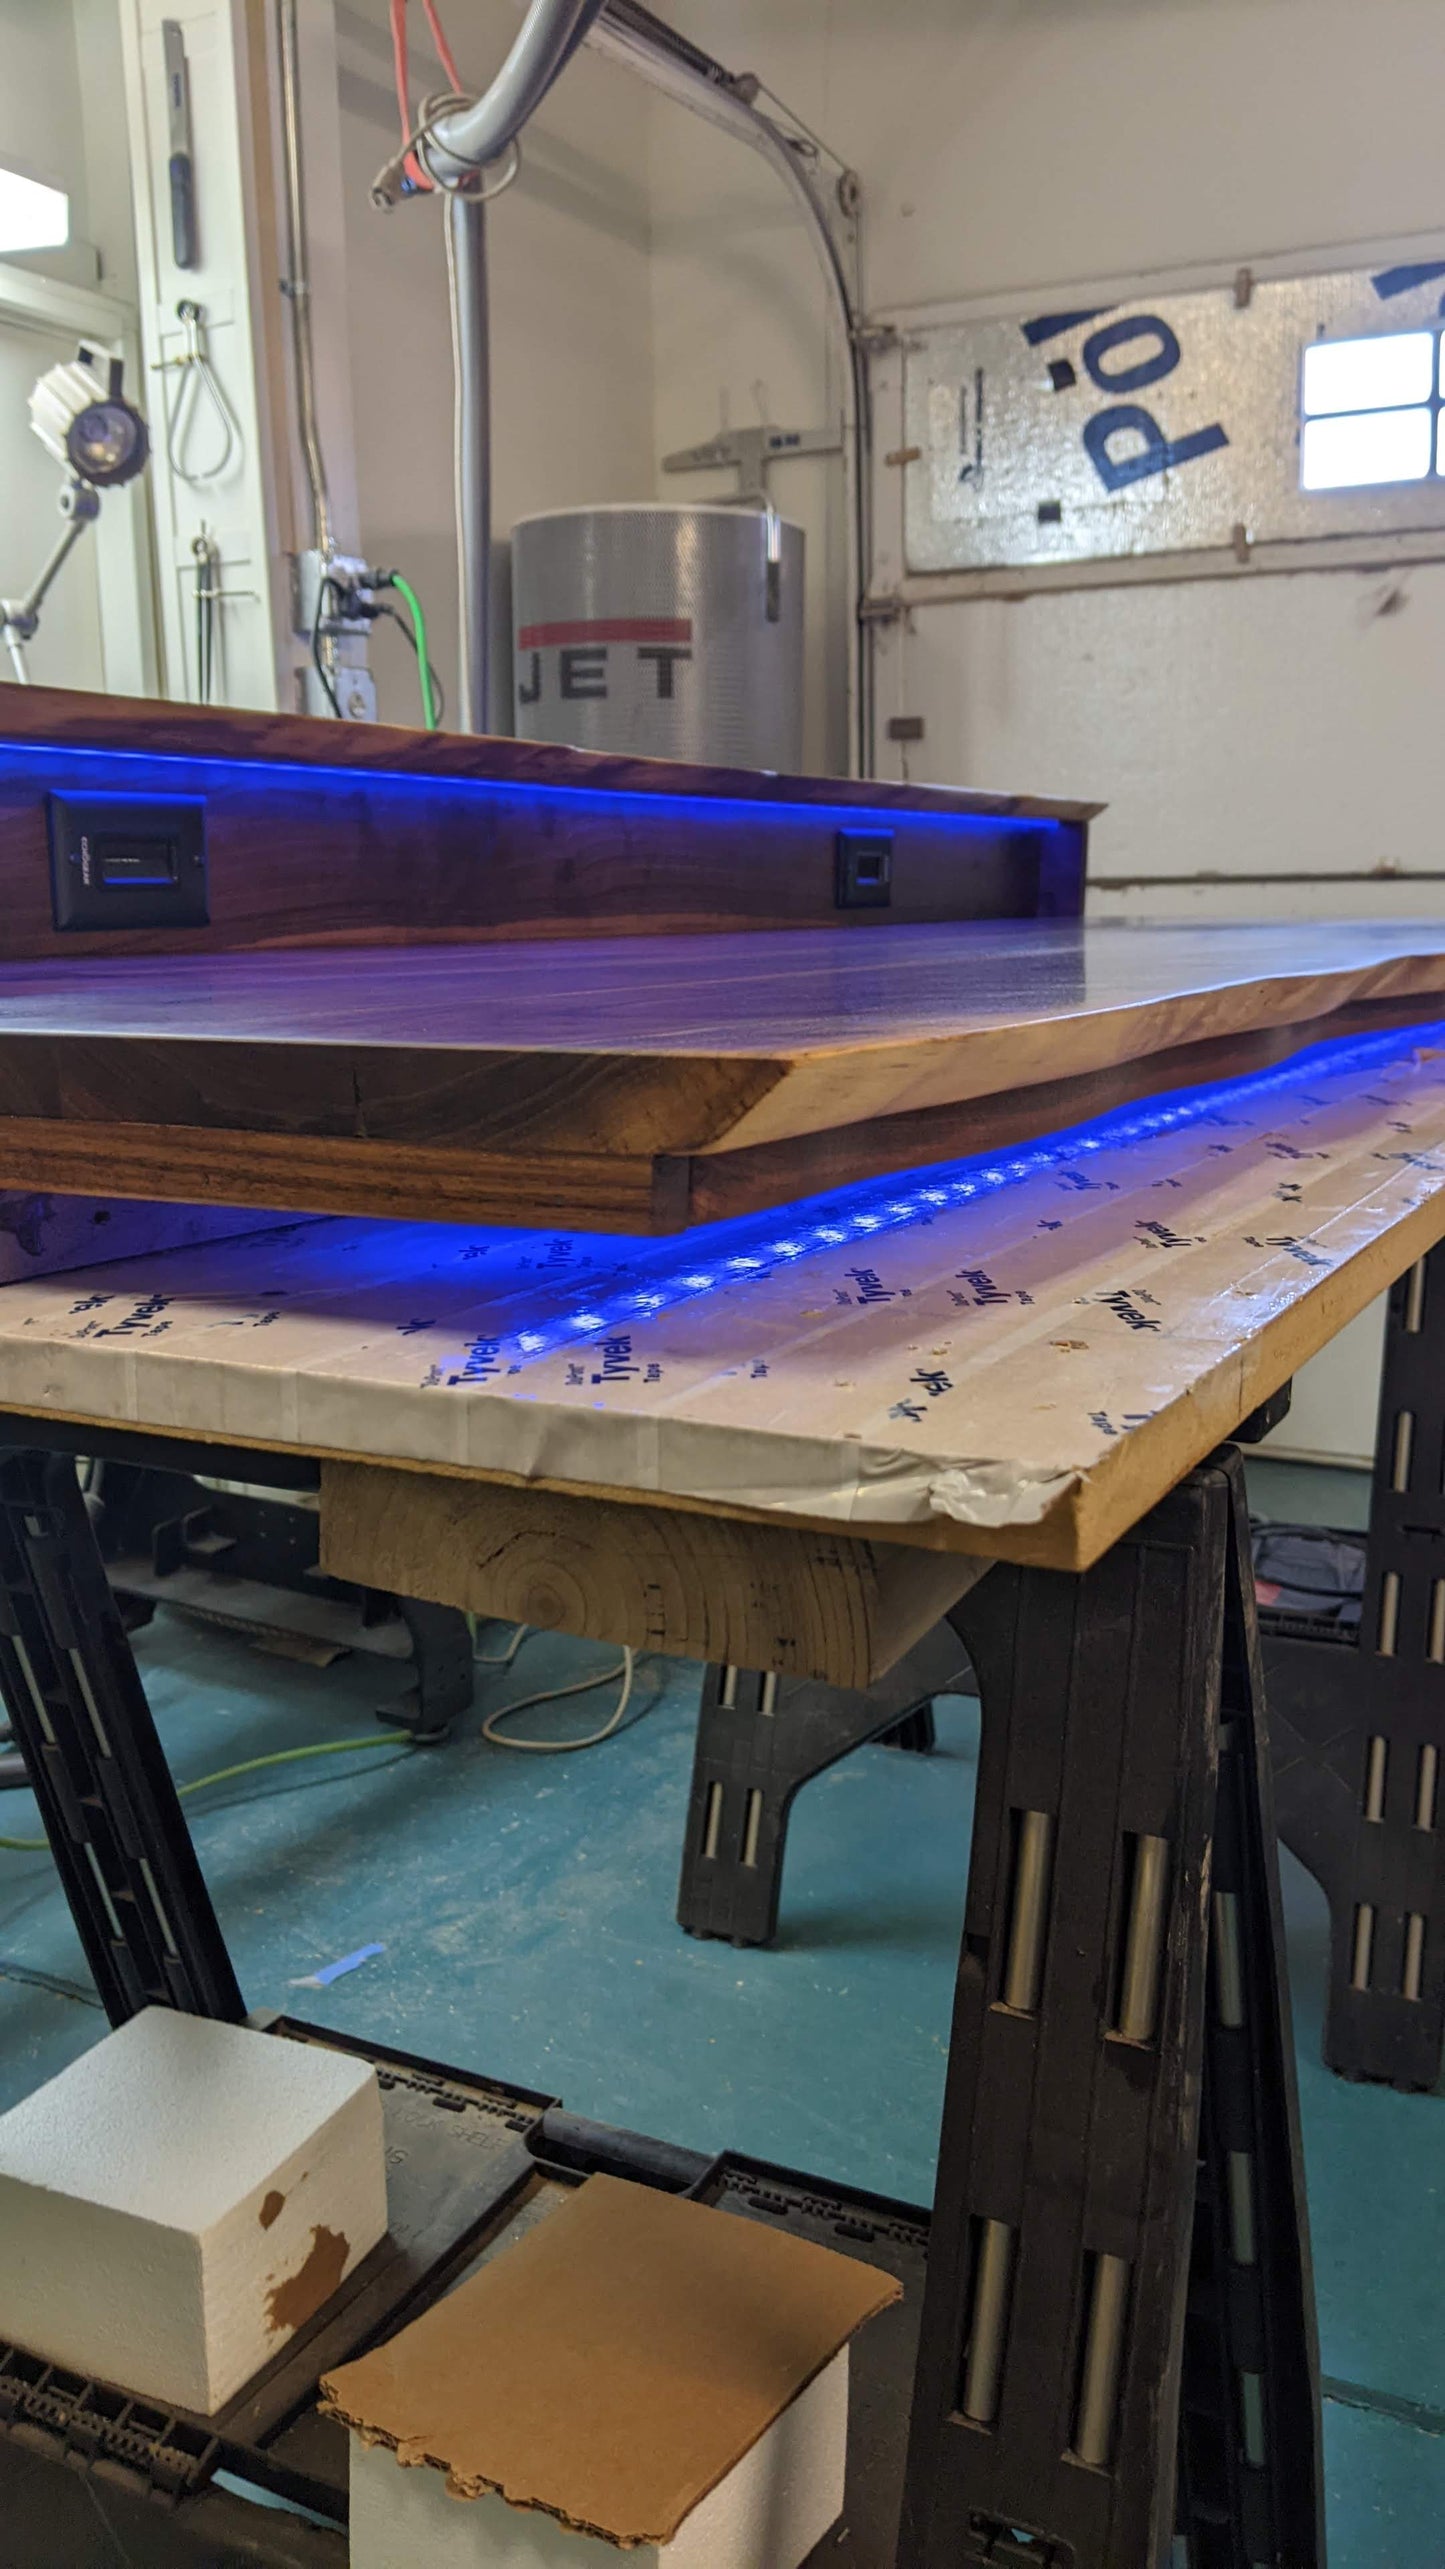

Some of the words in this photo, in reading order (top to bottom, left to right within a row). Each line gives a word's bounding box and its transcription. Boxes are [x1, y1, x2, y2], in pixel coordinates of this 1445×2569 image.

[519, 647, 692, 704] JET
[536, 1238, 576, 1268] Tyvek
[844, 1268, 896, 1304] Tyvek
[955, 1270, 1012, 1305] Tyvek
[93, 1294, 177, 1338] Tyvek
[1095, 1290, 1162, 1332] Tyvek
[447, 1335, 501, 1386] Tyvek
[592, 1335, 639, 1384] Tyvek
[644, 1364, 664, 1384] Tape
[1087, 1411, 1119, 1435] Tape
